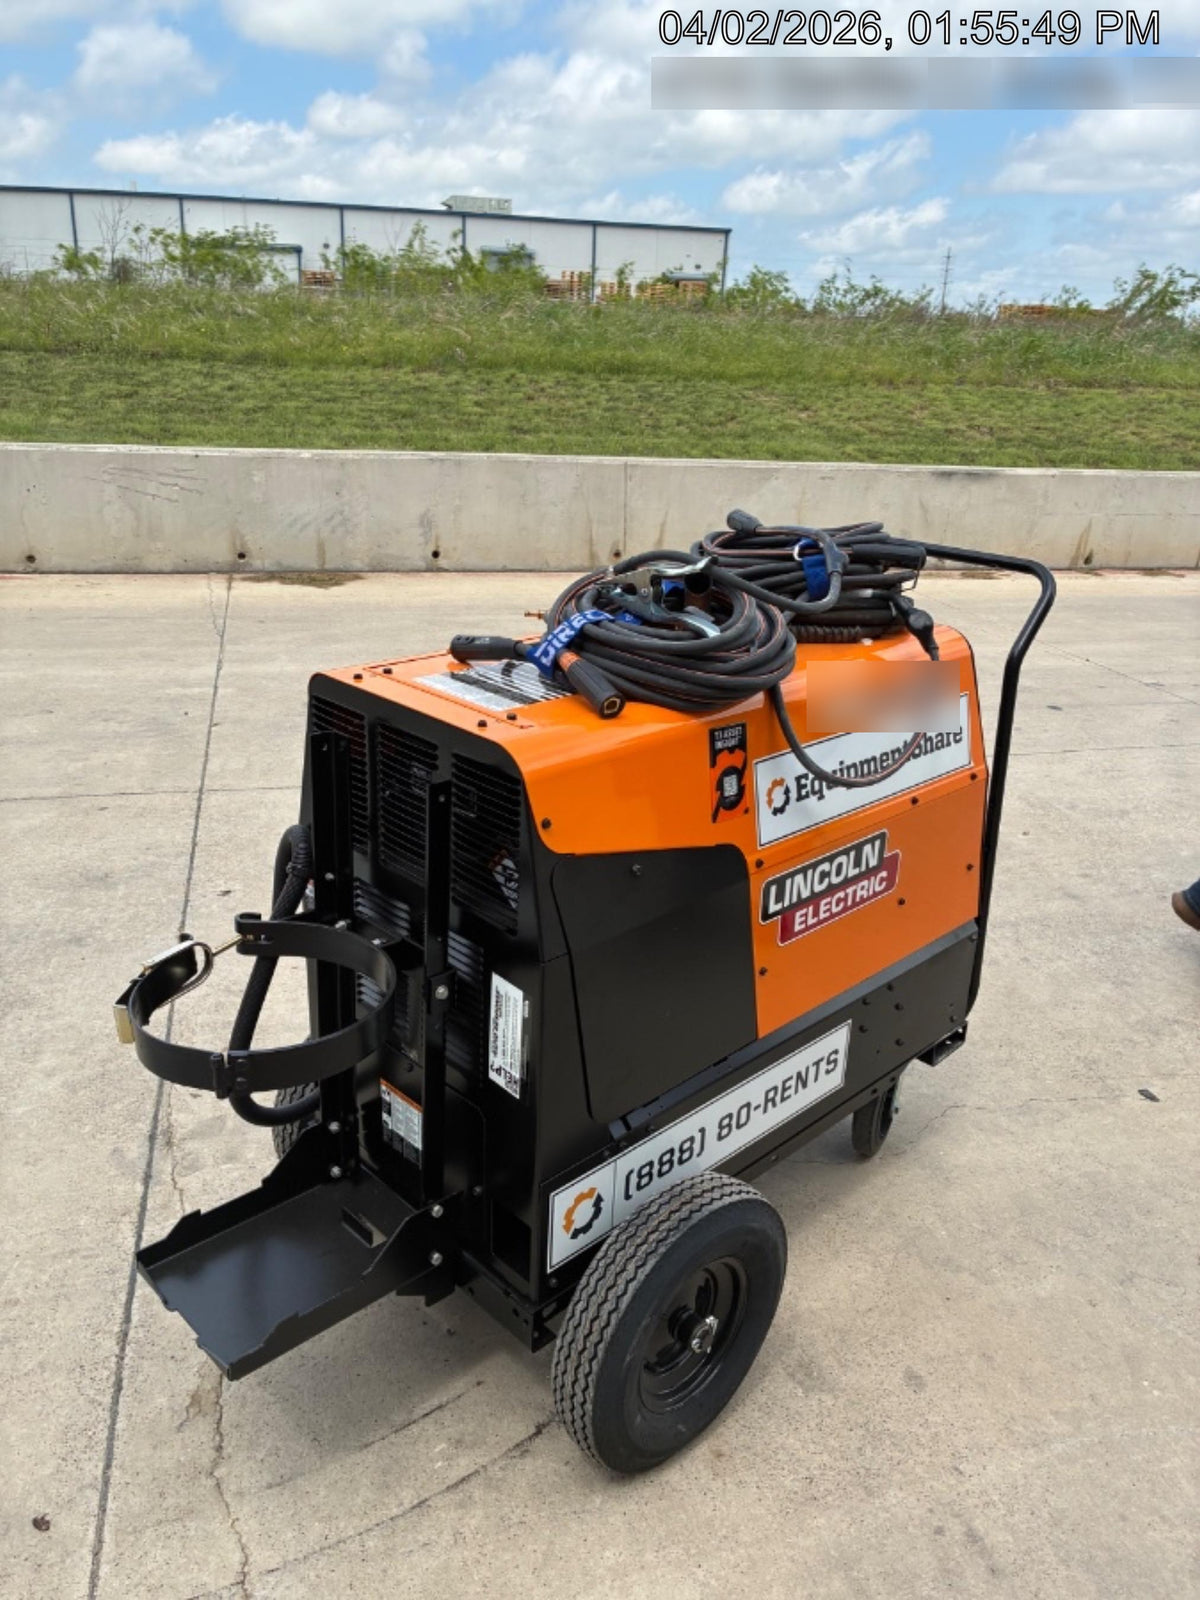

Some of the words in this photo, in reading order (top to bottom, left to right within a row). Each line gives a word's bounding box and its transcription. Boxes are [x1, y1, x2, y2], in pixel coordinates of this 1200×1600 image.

[768, 838, 881, 915] LINCOLN
[793, 870, 888, 933] ELECTRIC
[624, 1127, 706, 1200] (888)
[716, 1049, 840, 1142] 80-RENTS
